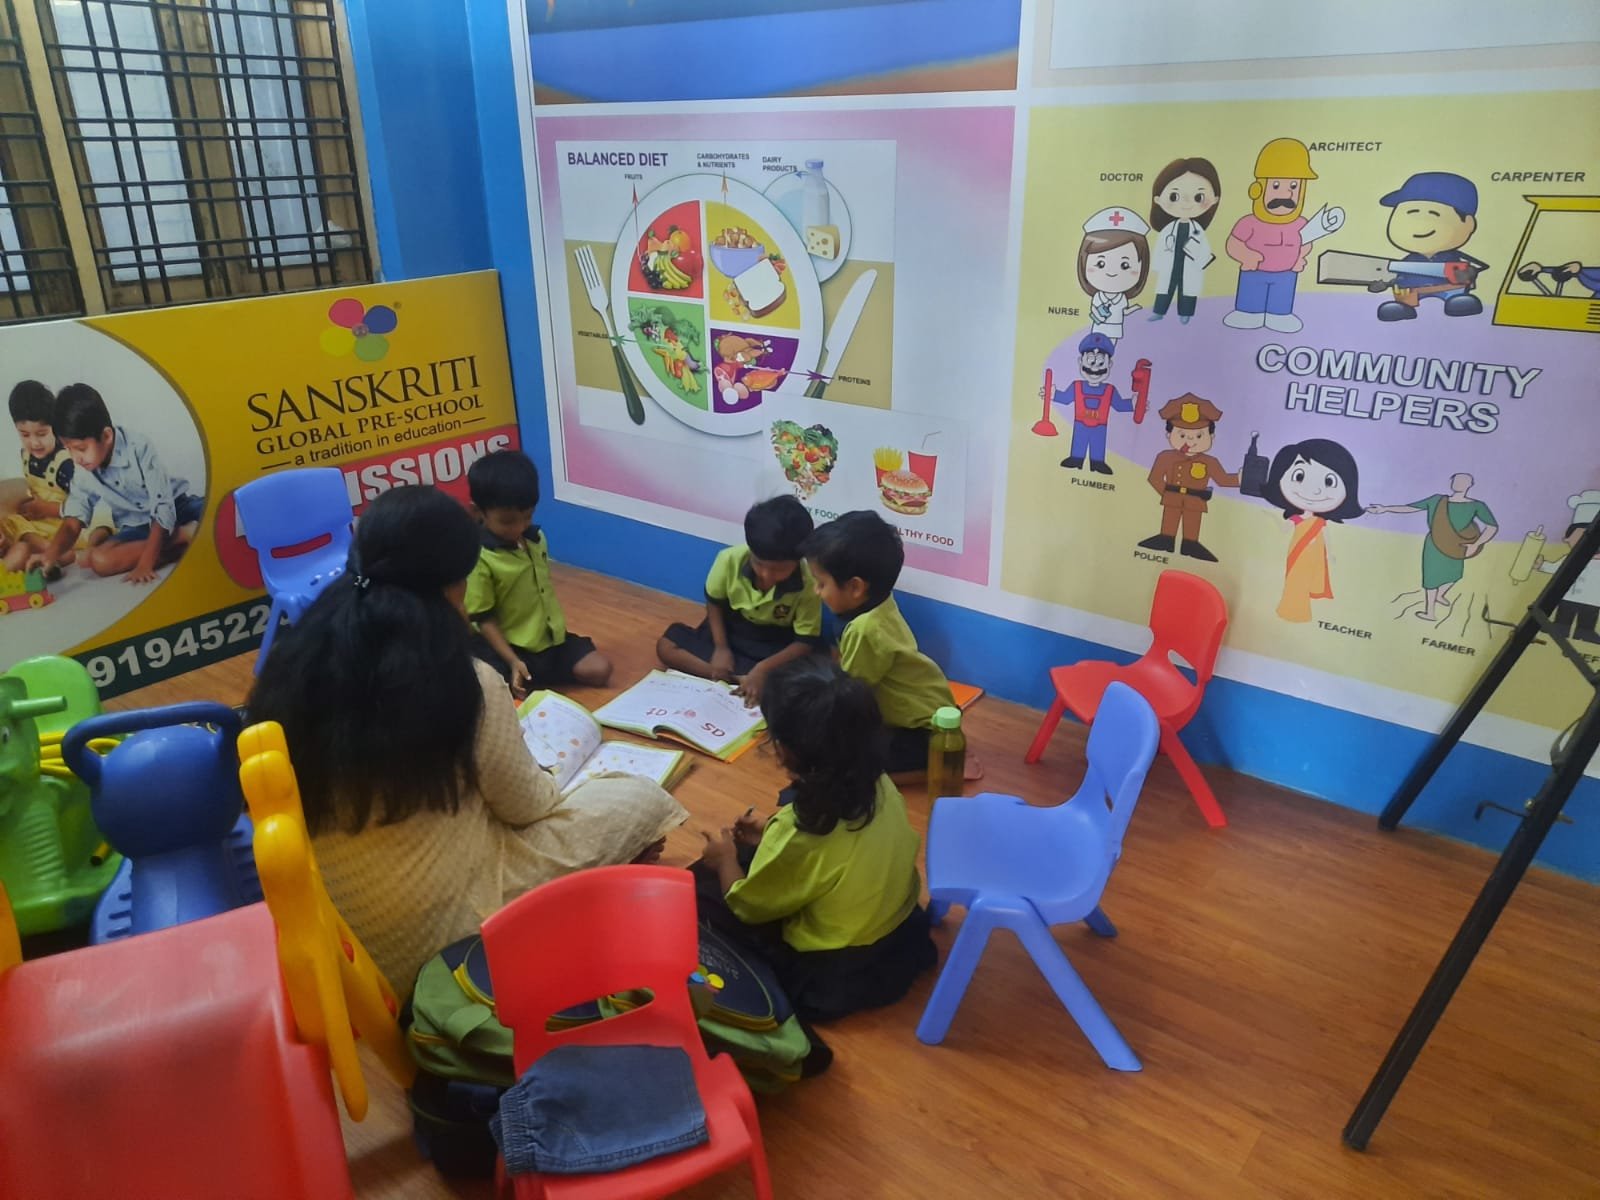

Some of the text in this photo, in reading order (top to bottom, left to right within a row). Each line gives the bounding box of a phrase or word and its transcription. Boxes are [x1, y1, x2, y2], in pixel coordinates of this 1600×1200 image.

[1308, 141, 1382, 152] ARCHITECT
[567, 151, 668, 167] BALANCED DIET
[696, 153, 750, 161] CARBOHYDRATES
[762, 156, 782, 164] DAIRY
[703, 161, 736, 169] NUTRIENTS
[762, 165, 798, 173] PRODUCTS
[624, 173, 643, 181] FRUITS
[1099, 172, 1144, 183] DOCTOR
[1490, 170, 1586, 183] CARPENTER
[1047, 305, 1080, 316] NURSE
[1256, 343, 1543, 399] COMMUNITY
[838, 375, 871, 386] PROTEINS
[247, 355, 481, 433] SANSKRITI
[1284, 381, 1500, 435] HELPERS
[255, 393, 484, 456] GLOBAL PRE-SCHOOL
[294, 418, 462, 467] a tradition in education
[1070, 477, 1117, 493] PLUMBER
[926, 533, 955, 547] FOOD
[1133, 550, 1170, 565] POLICE
[1316, 620, 1373, 640] TEACHER
[1421, 637, 1476, 657] FARMER
